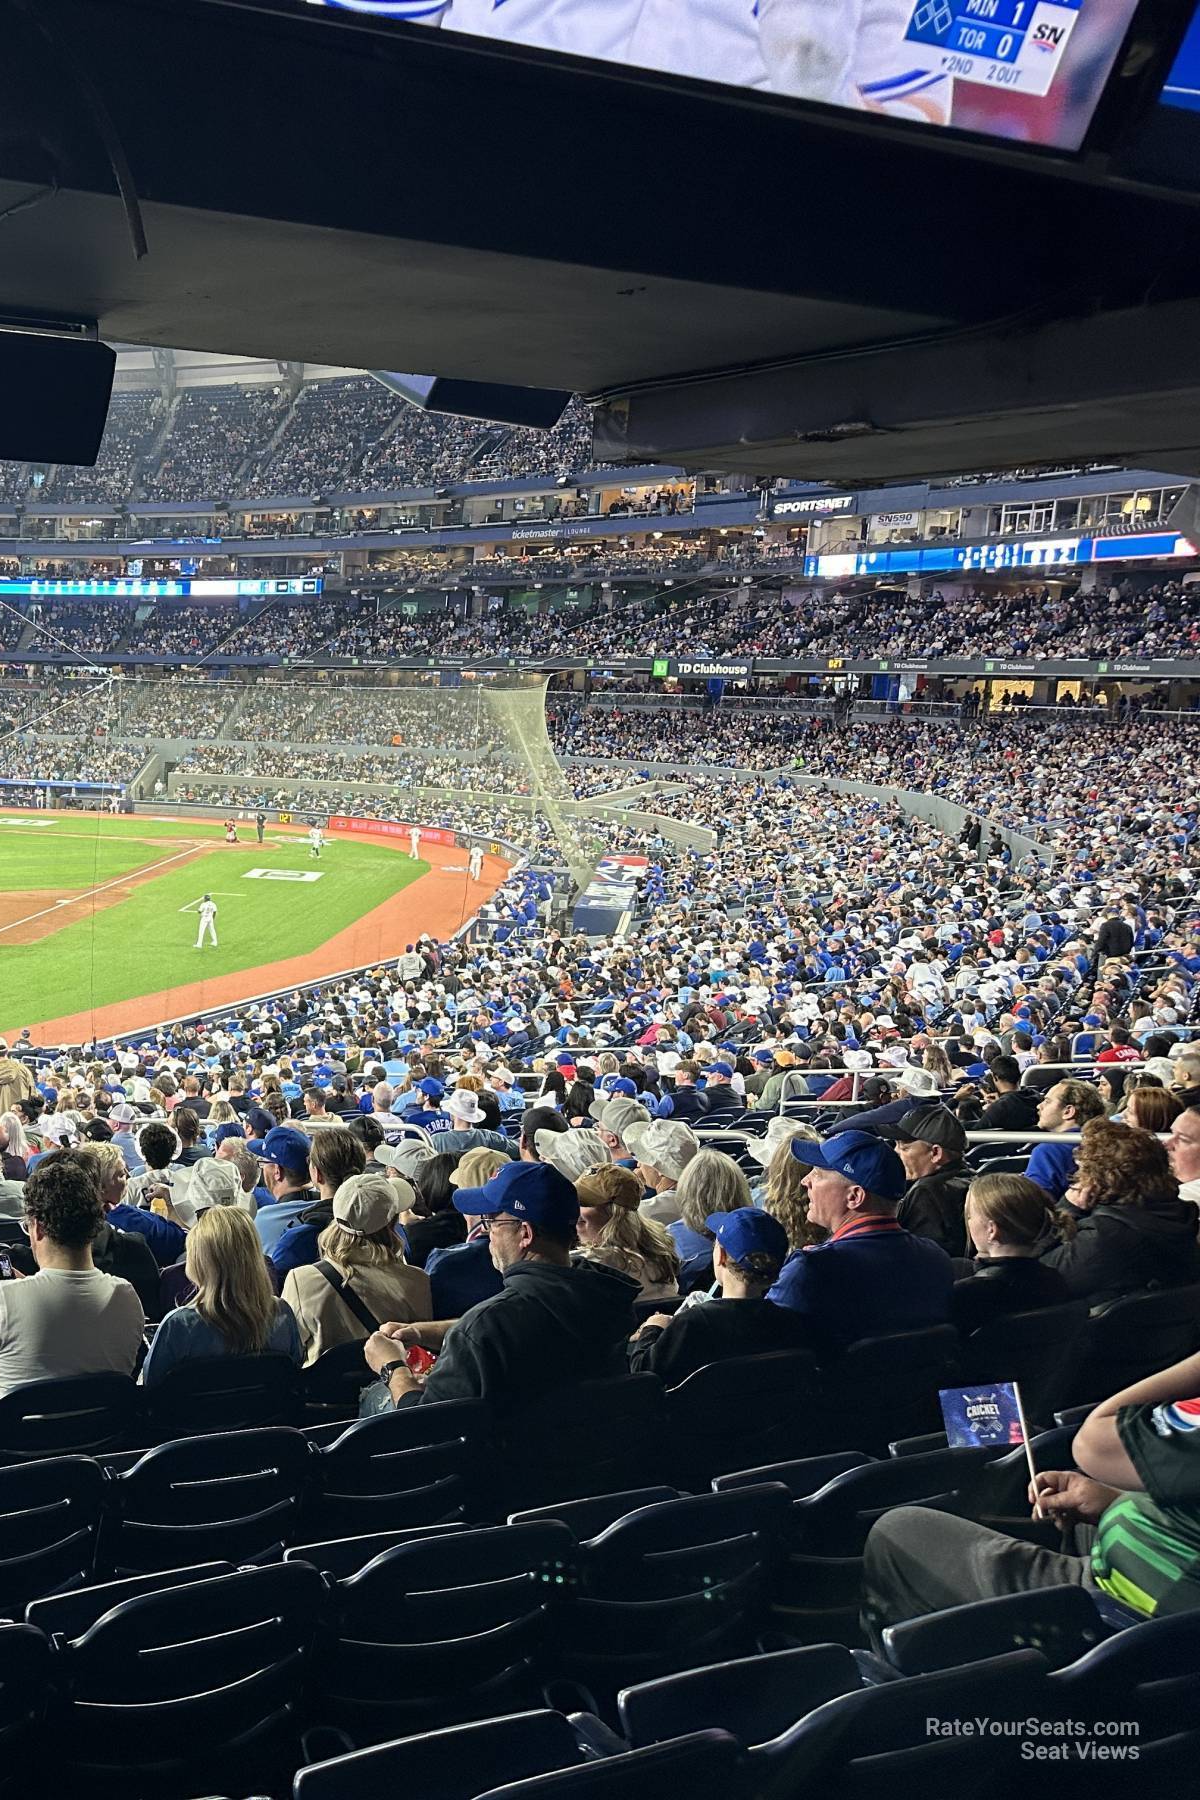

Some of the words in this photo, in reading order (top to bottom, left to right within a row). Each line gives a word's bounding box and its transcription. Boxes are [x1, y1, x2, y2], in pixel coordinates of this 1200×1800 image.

[966, 0, 998, 18] MIN
[1012, 1, 1025, 26] 1
[957, 27, 986, 50] TOR
[996, 34, 1013, 59] 0
[1032, 23, 1066, 45] SN
[946, 57, 974, 75] 2ND
[986, 65, 996, 81] 2
[998, 67, 1023, 84] OUT
[773, 496, 852, 514] SPORTSNET
[878, 513, 912, 523] SN590
[512, 529, 559, 539] ticketmaster
[678, 664, 692, 673] TD
[693, 663, 748, 674] Clubhouse
[966, 1403, 1000, 1418] CRICKET
